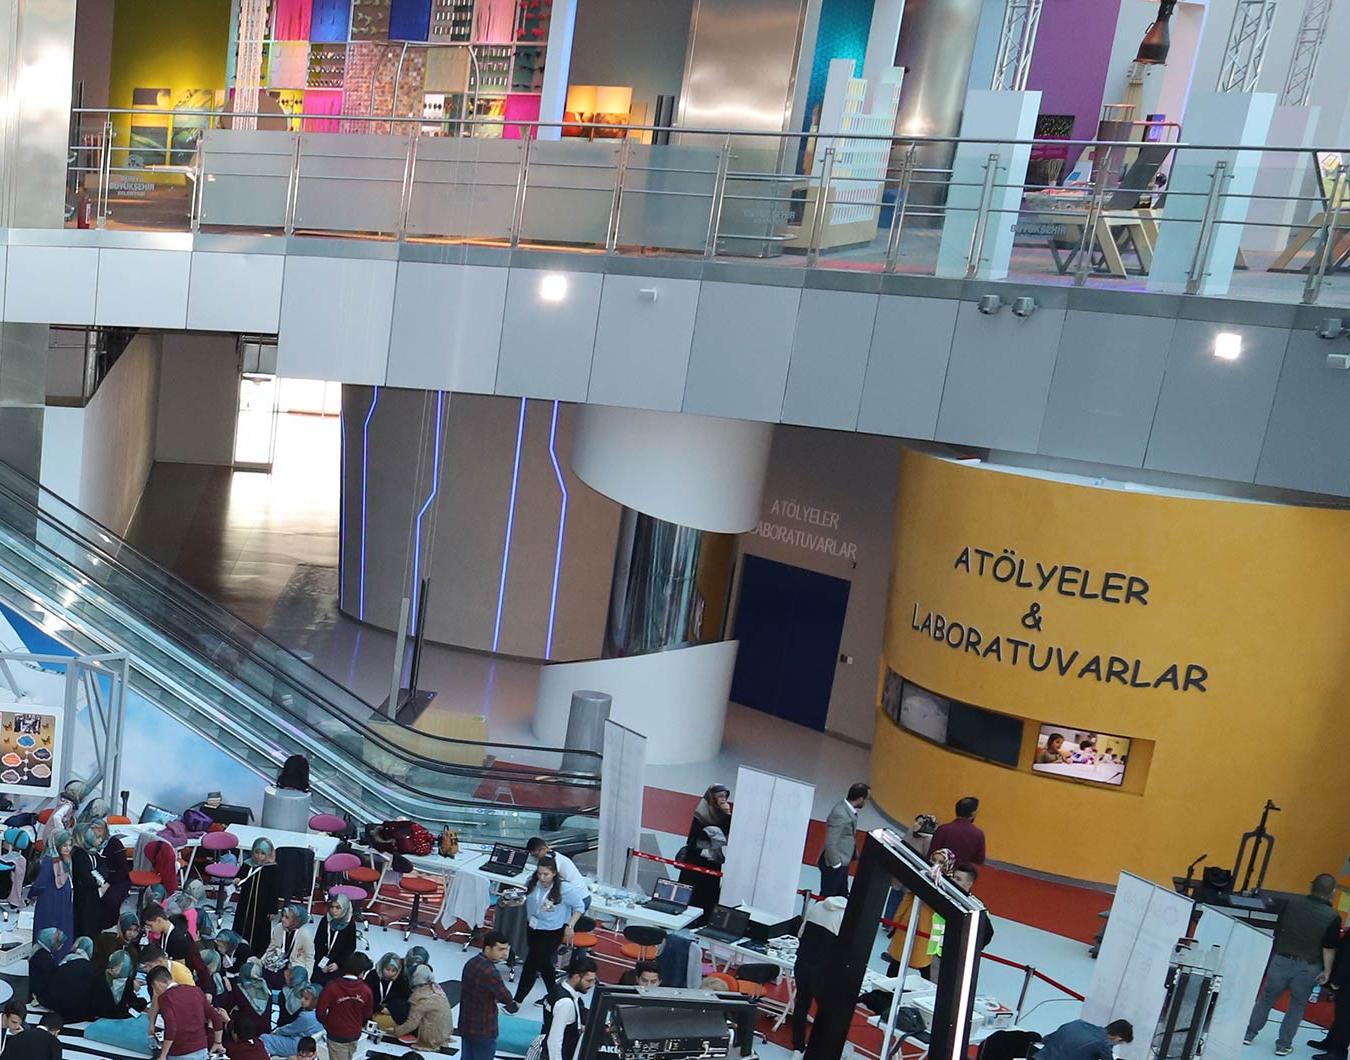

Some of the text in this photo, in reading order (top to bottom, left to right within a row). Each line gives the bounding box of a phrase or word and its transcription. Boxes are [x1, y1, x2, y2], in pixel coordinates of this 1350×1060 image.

[769, 499, 840, 530] ATÖLYELER
[750, 519, 857, 561] ABORATUVARLAR
[954, 546, 1150, 606] ATÖLYELER
[1020, 602, 1043, 632] &
[911, 602, 1209, 693] LABORATUVARLAR
